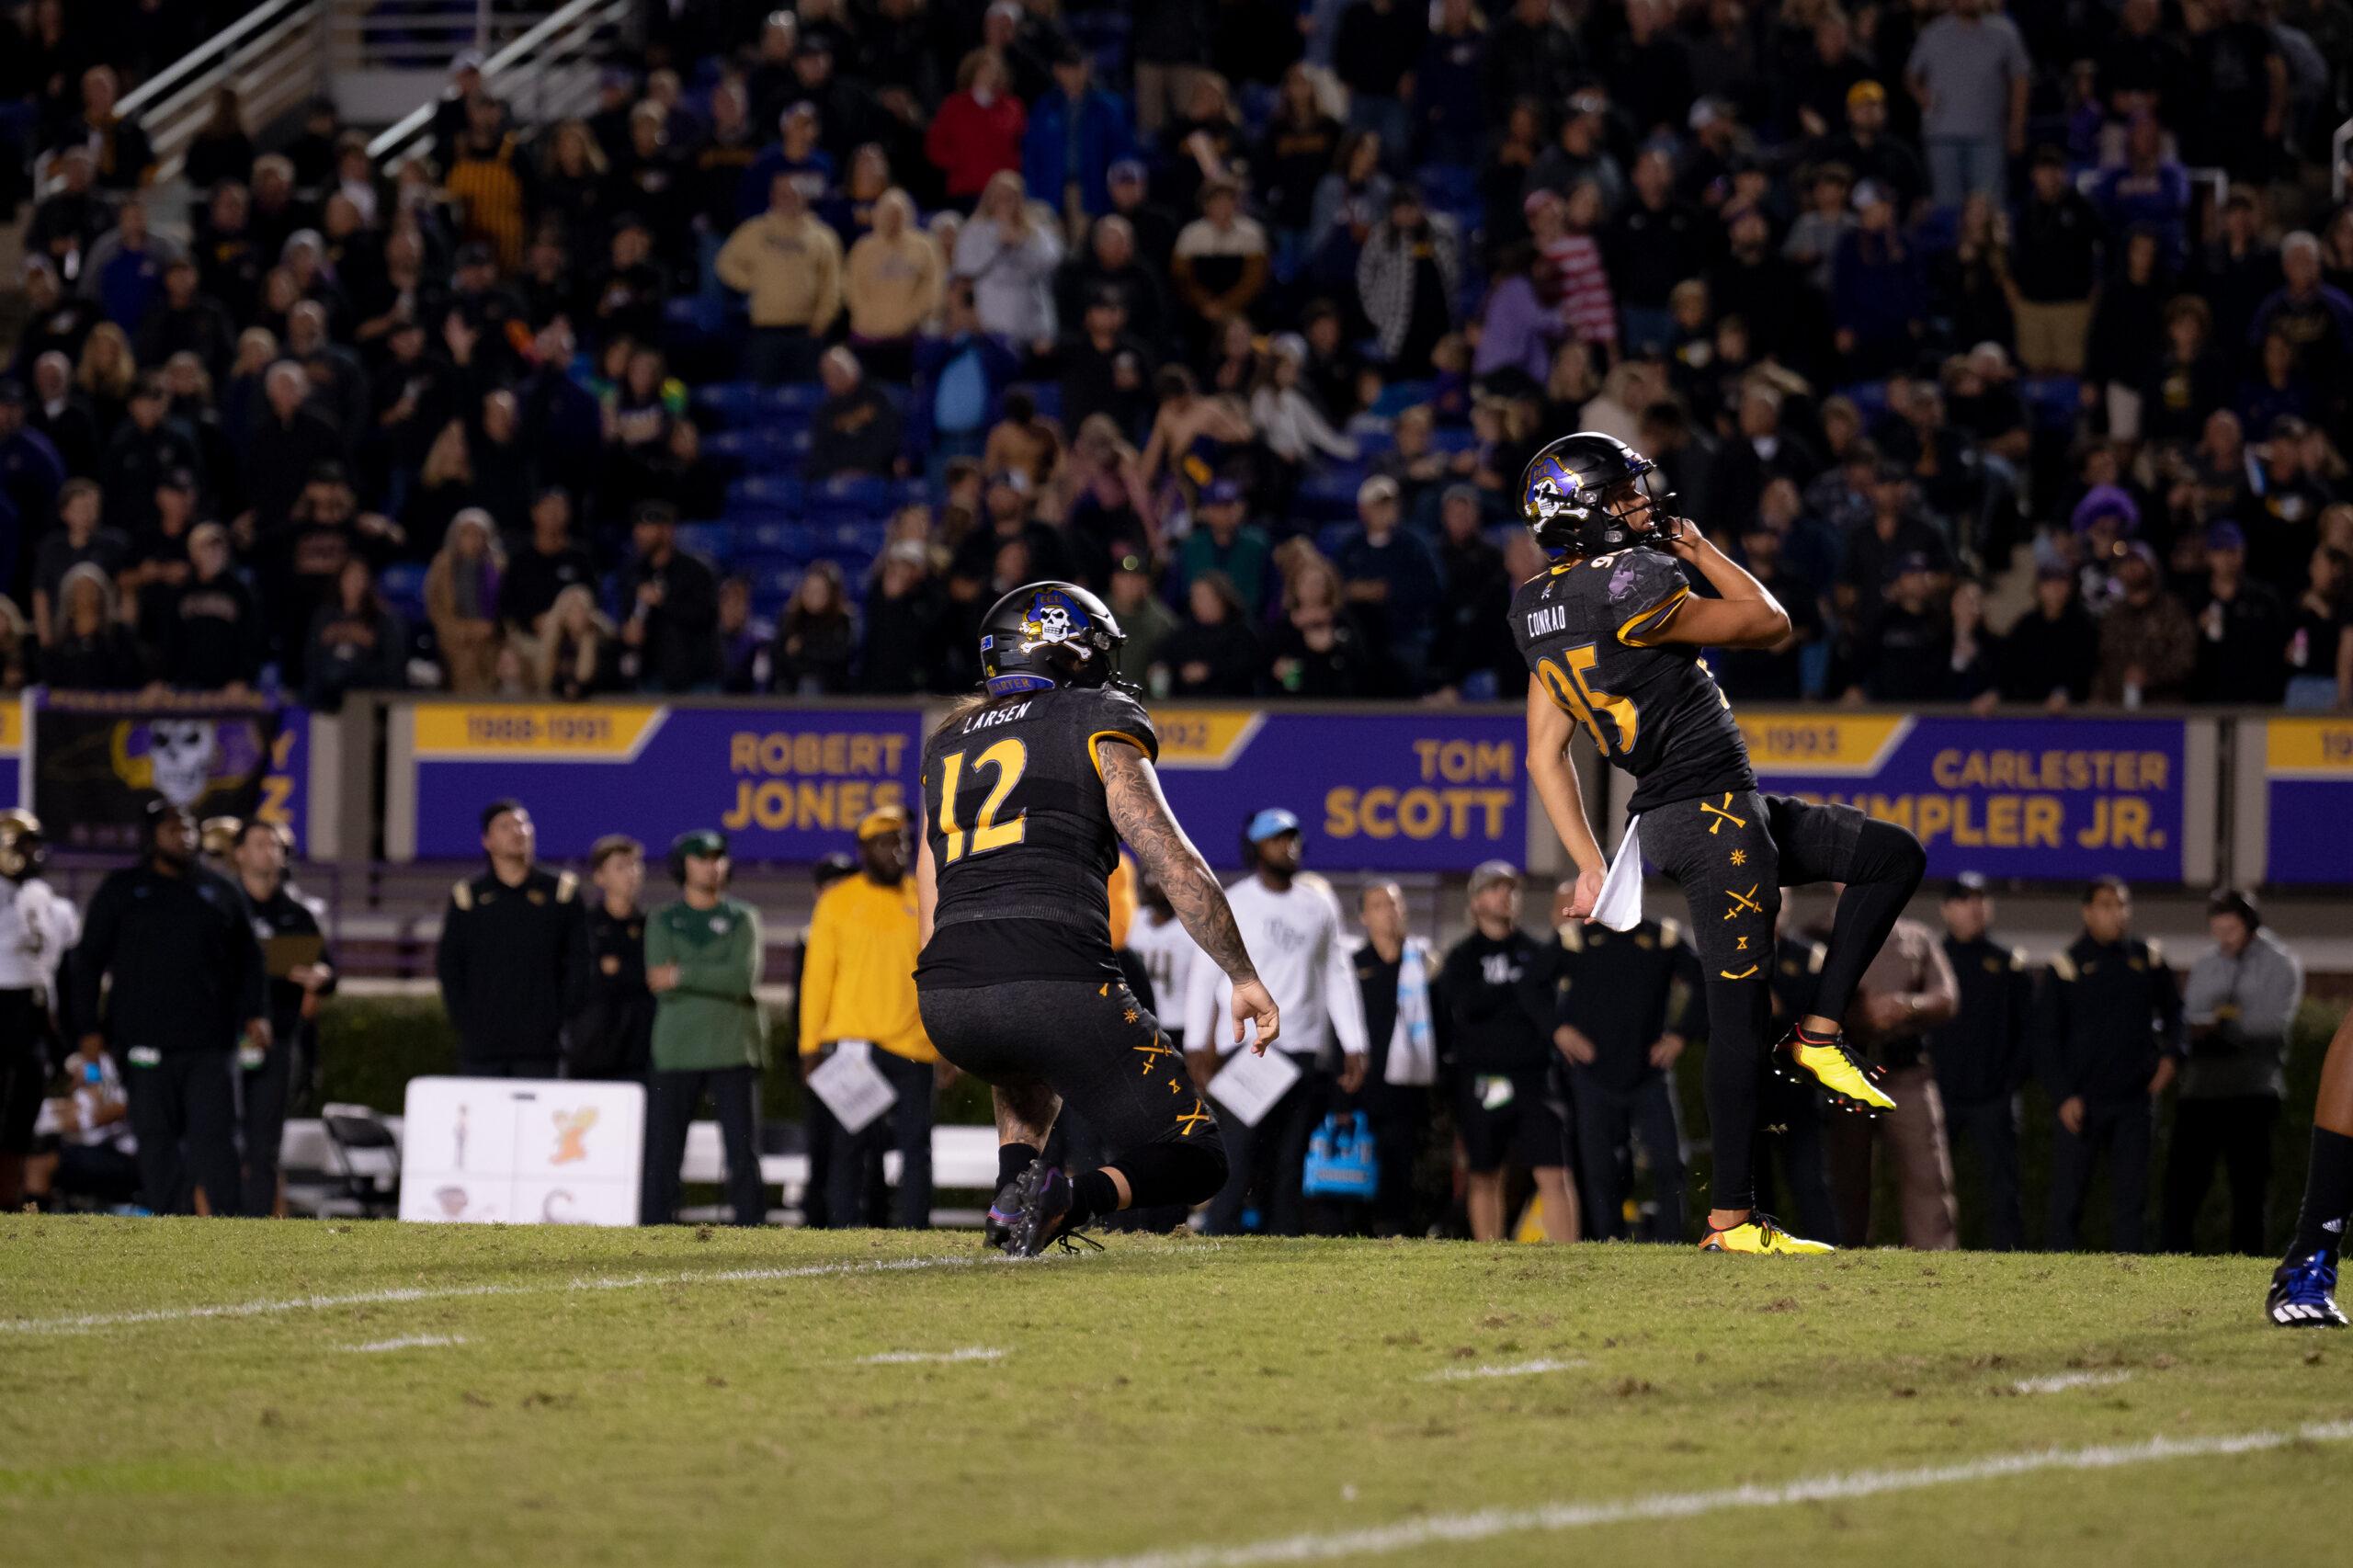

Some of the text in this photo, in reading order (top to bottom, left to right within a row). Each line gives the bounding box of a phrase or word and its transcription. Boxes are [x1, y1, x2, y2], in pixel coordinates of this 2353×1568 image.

[1533, 463, 1551, 480] ECU
[1040, 595, 1063, 604] ECU
[1527, 605, 1566, 638] CONRAD
[961, 700, 1032, 735] LARSEN
[1536, 642, 1639, 756] 95
[730, 732, 909, 775] ROBERT
[1413, 739, 1515, 782] TOM
[1931, 748, 2170, 790] CARLESTER
[939, 736, 1028, 867] 12
[1324, 785, 1515, 840] SCOTT
[2076, 796, 2167, 849] JR.
